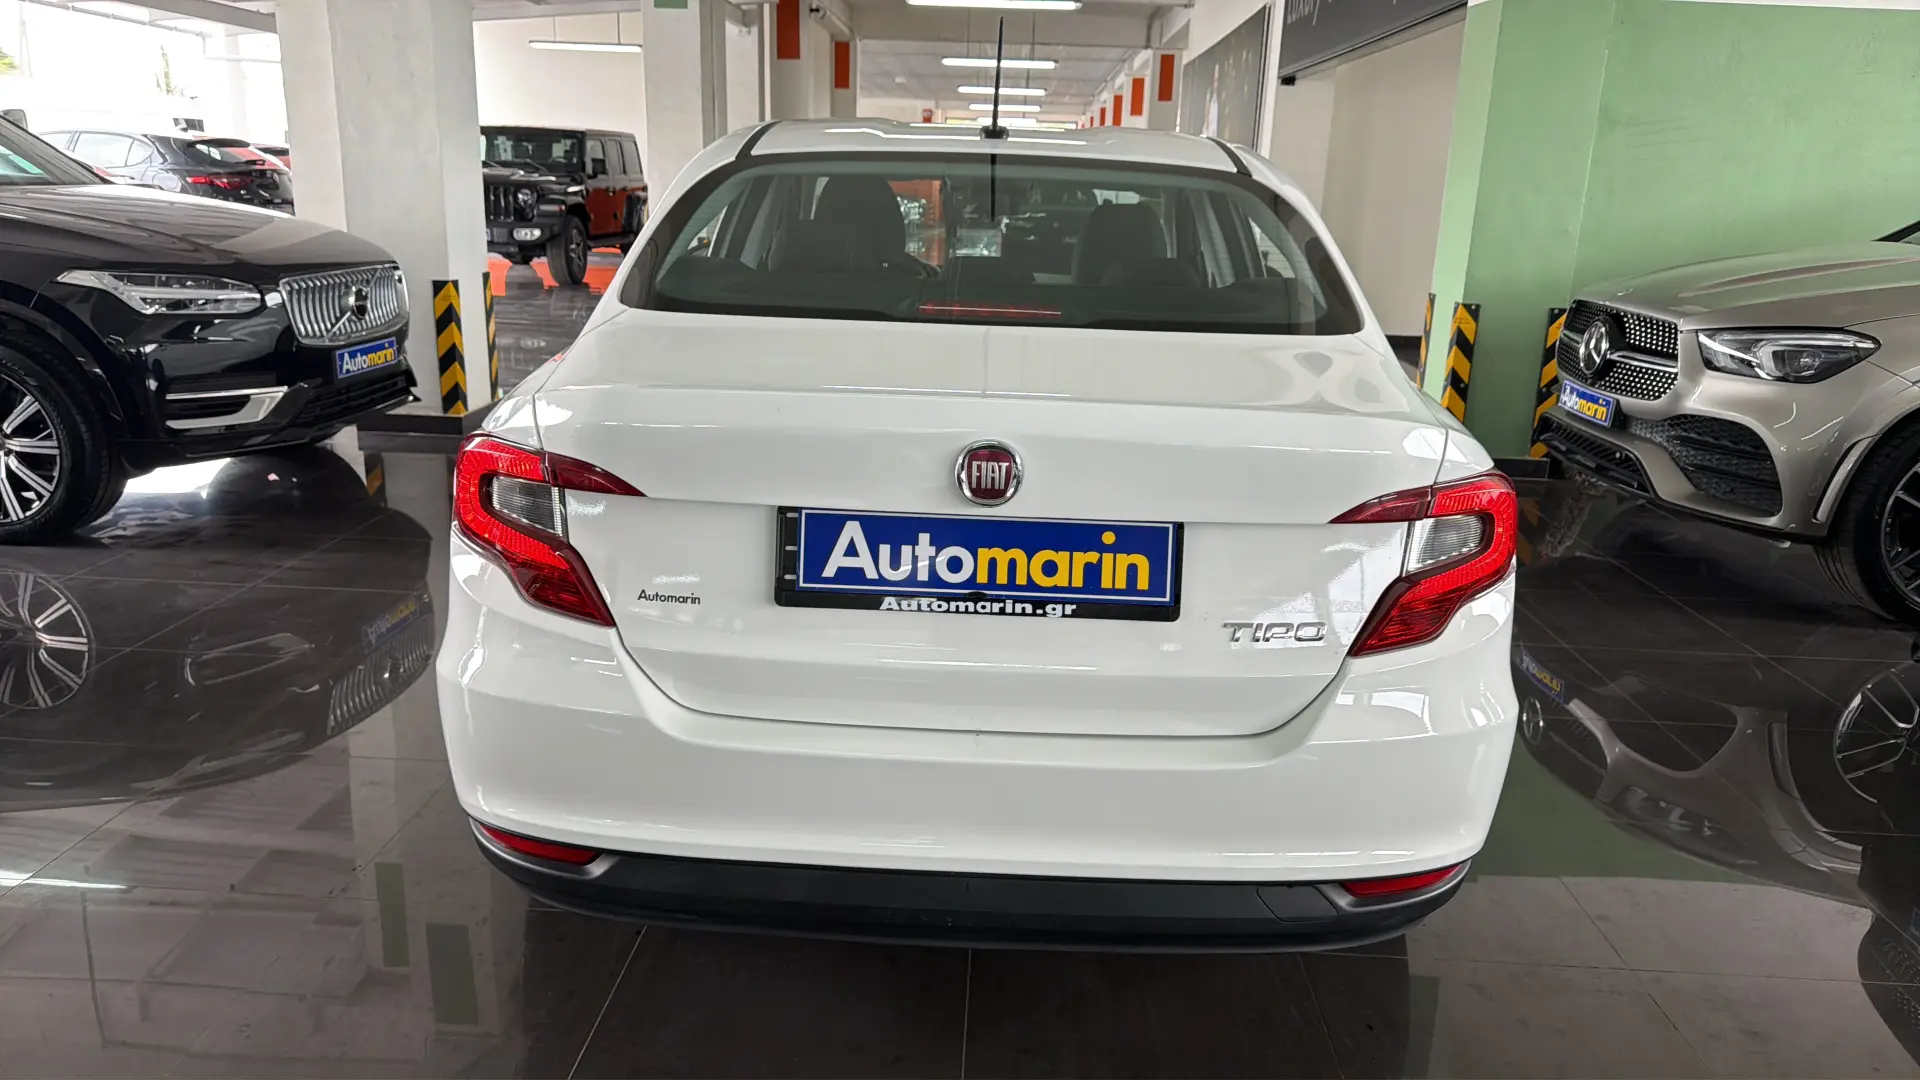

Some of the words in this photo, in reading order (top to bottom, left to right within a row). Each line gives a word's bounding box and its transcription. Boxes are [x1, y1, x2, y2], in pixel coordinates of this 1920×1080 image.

[342, 342, 395, 374] Automarin
[1561, 384, 1608, 422] Automarin
[971, 460, 1010, 490] FIAT
[821, 519, 1150, 591] Automarin
[637, 588, 701, 605] Automarin
[880, 596, 1077, 618] Automarin.gr
[1222, 621, 1328, 642] TIPO
